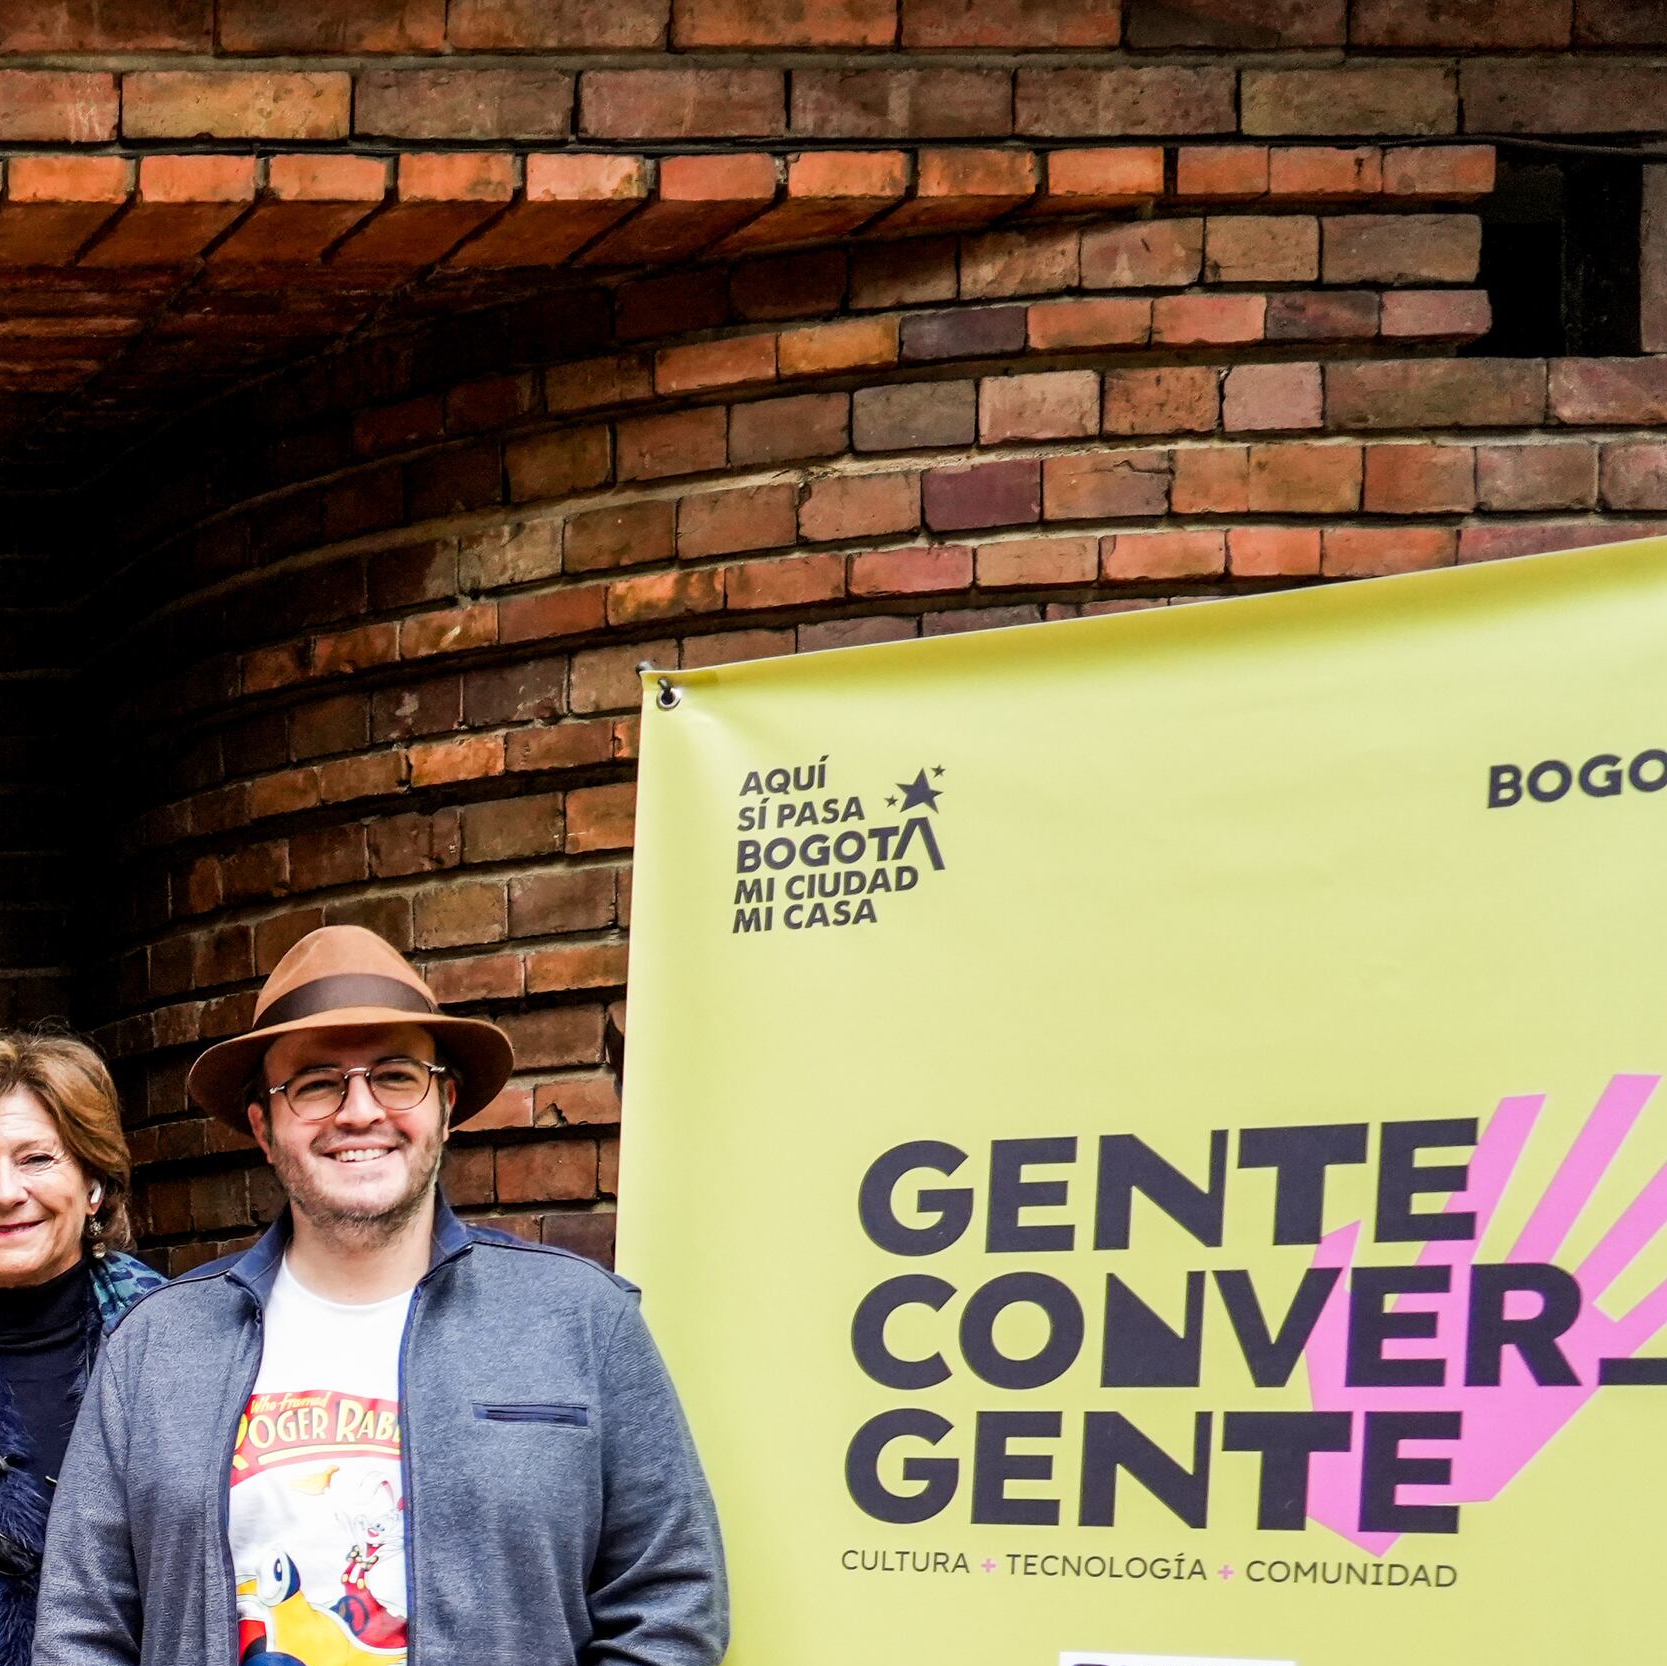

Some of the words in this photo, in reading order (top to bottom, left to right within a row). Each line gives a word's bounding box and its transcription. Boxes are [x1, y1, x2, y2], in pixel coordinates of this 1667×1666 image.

[739, 754, 829, 796] AQUÍ
[737, 797, 770, 832] SÍ
[777, 796, 865, 829] PASA
[734, 878, 775, 905] MI
[785, 865, 919, 901] CIUDAD
[732, 906, 774, 934] MI
[783, 898, 878, 930] CASA
[858, 1117, 1479, 1257] GENTE
[844, 1407, 1463, 1534] GENTE
[841, 1549, 970, 1573] CULTURA
[1006, 1553, 1207, 1580] TECNOLOGÍA
[1246, 1560, 1457, 1588] COMUNIDAD
